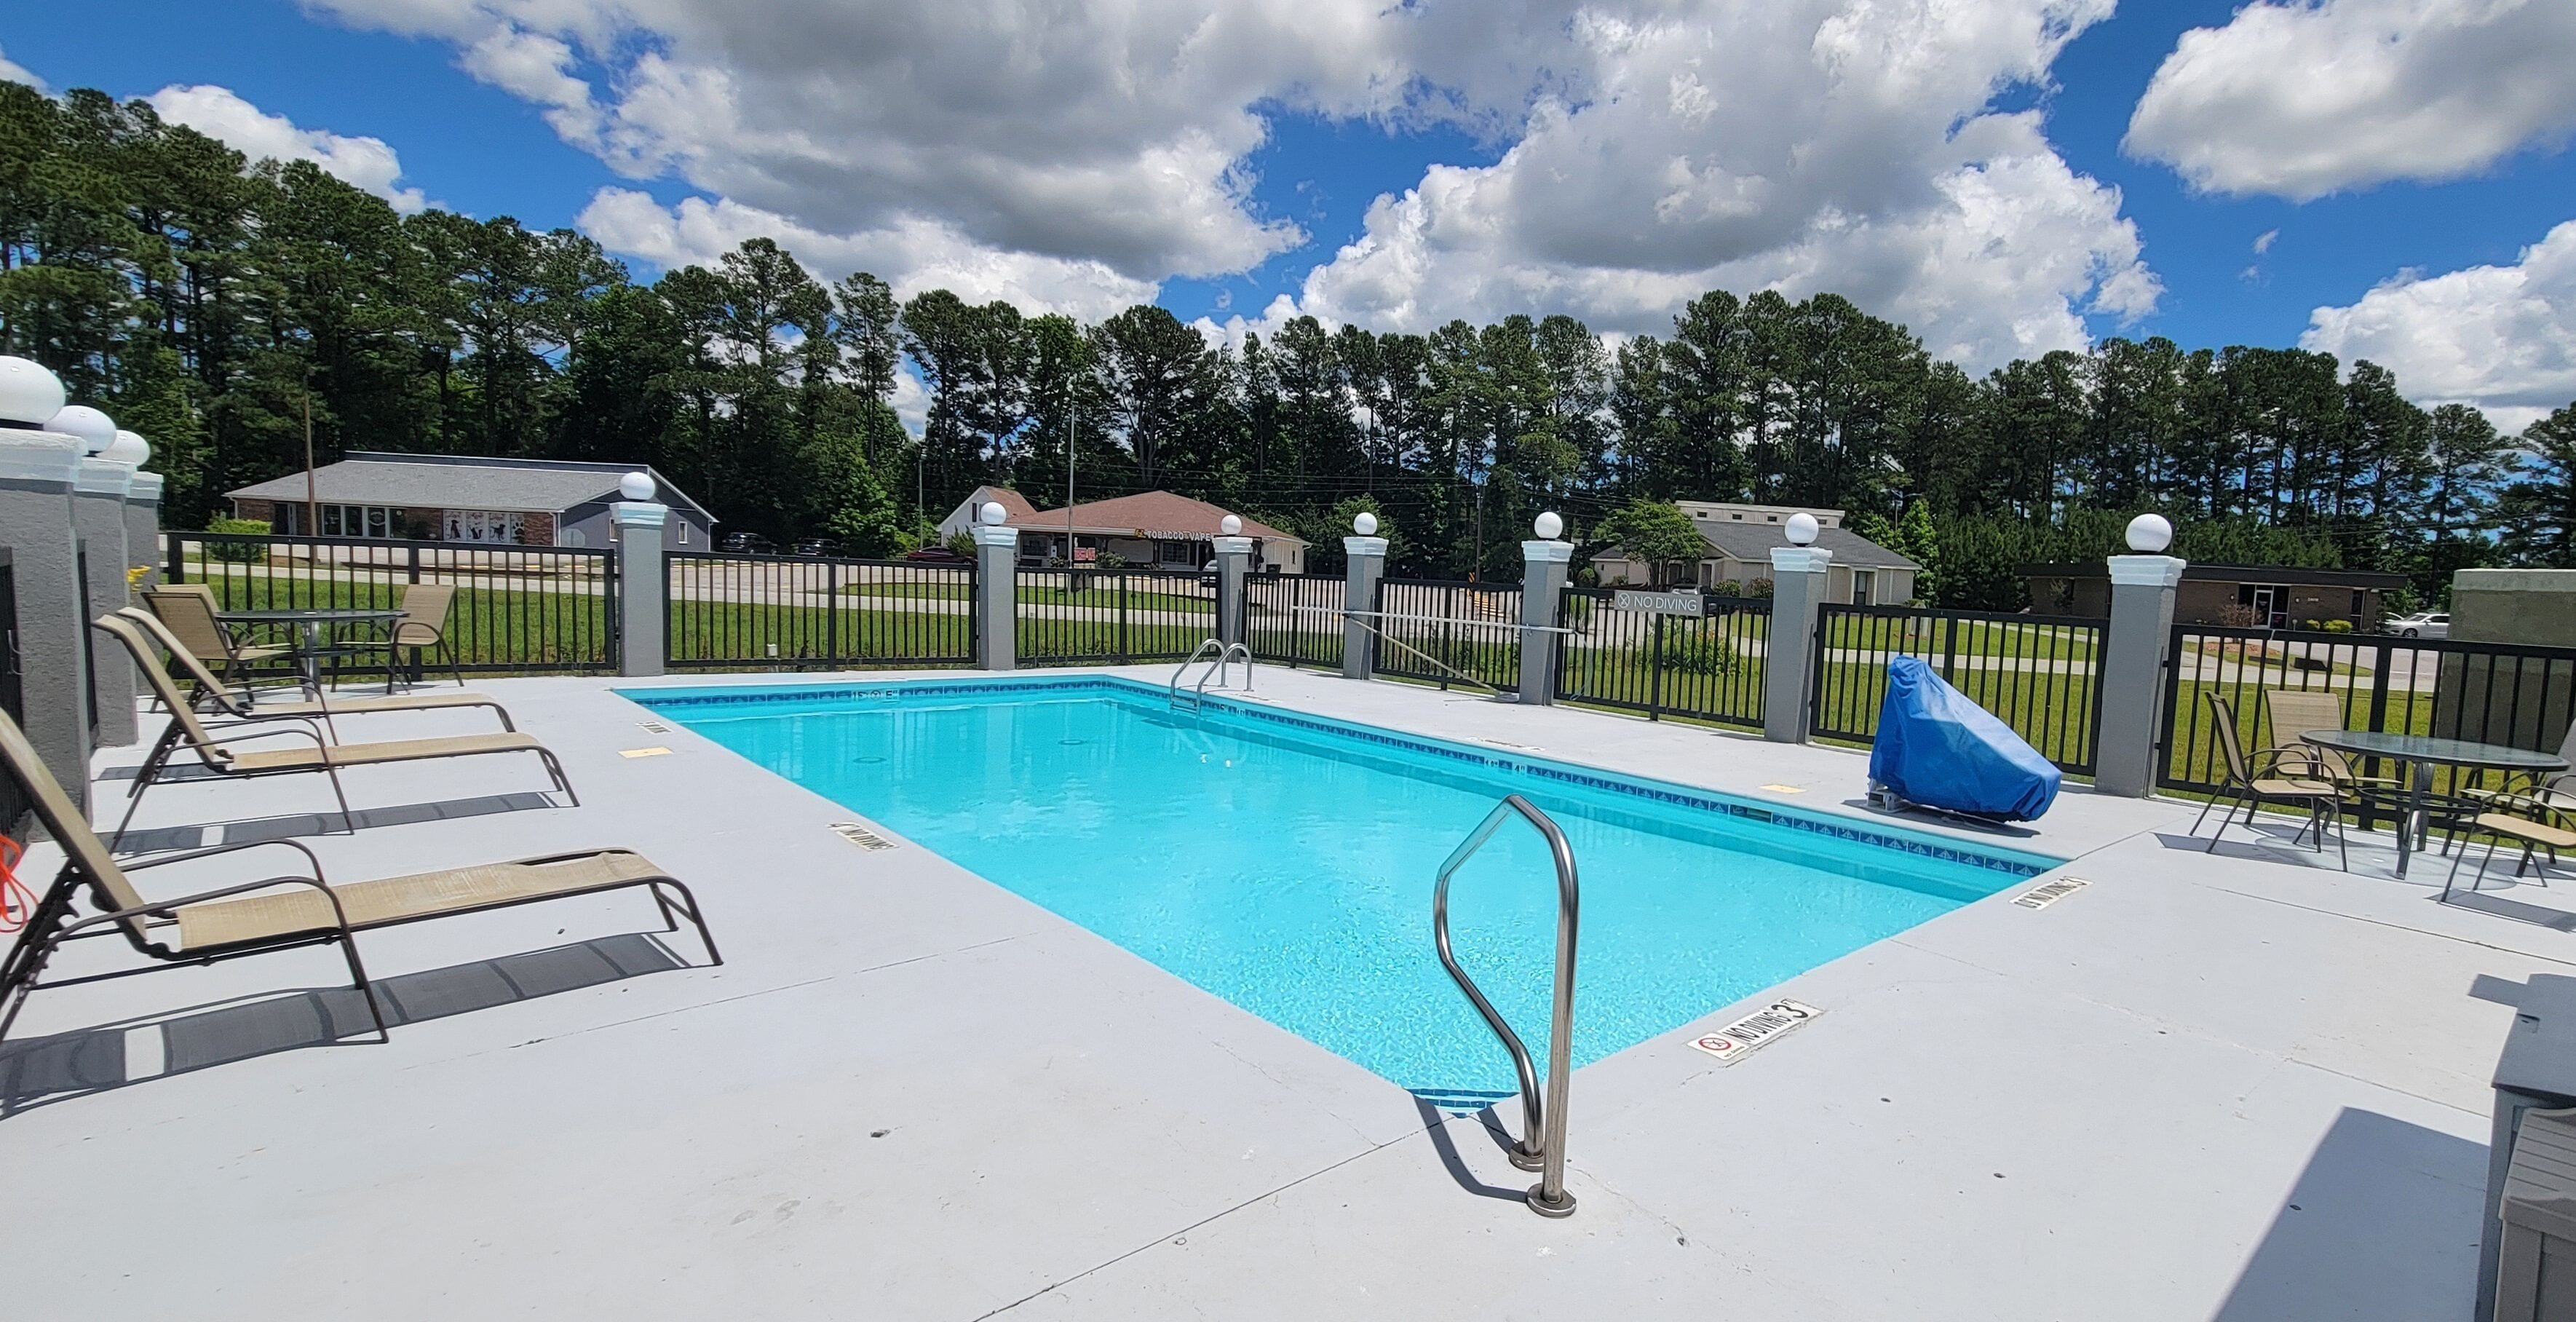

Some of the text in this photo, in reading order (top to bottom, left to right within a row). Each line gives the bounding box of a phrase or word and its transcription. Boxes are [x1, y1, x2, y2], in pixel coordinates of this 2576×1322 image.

[1146, 530, 1184, 539] TOBACCO
[1189, 532, 1211, 542] VAPE
[1633, 595, 1697, 611] NO DIVING
[1771, 1004, 1809, 1018] 3
[1737, 1011, 1792, 1034] DIVING
[1721, 1026, 1761, 1042] NO
